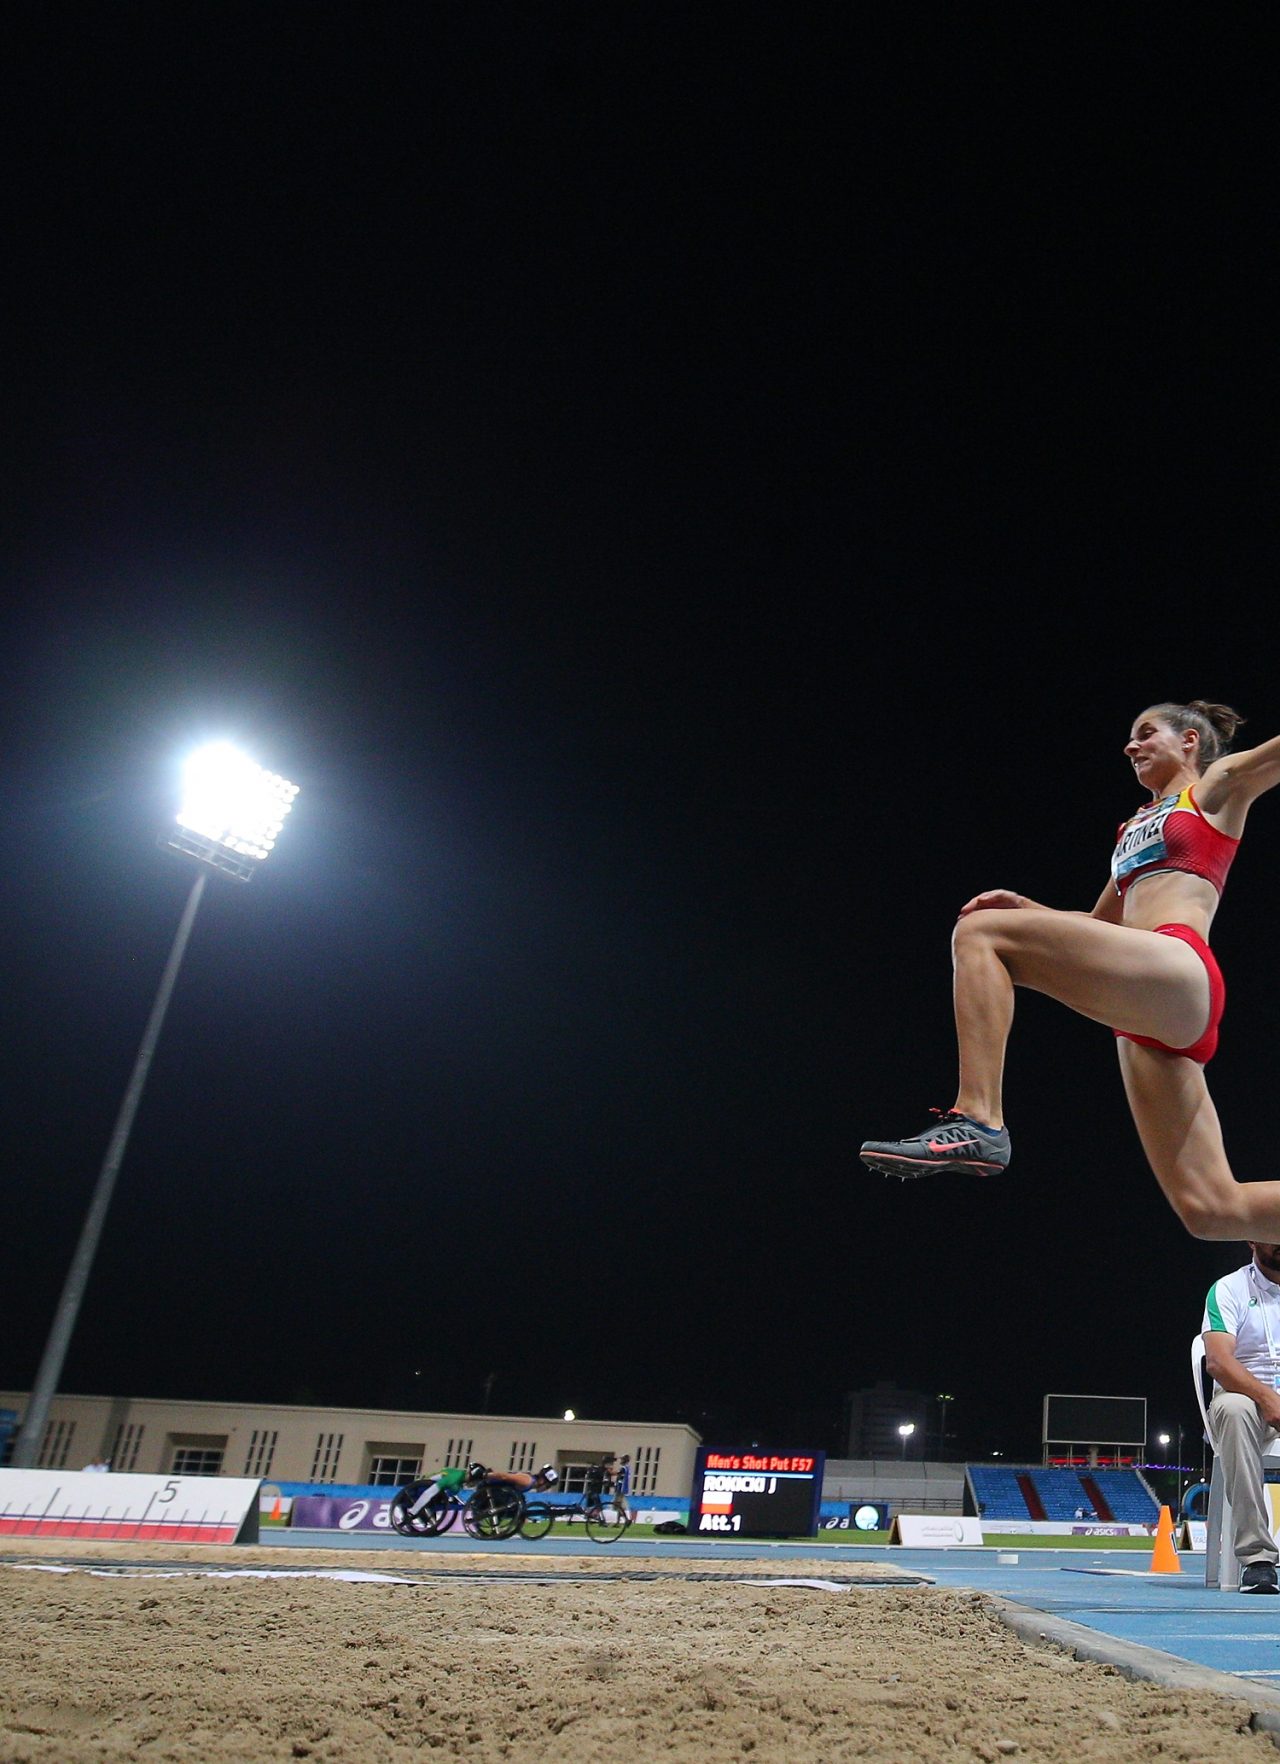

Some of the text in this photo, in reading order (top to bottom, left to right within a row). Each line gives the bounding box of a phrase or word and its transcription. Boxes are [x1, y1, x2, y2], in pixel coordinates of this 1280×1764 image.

[1116, 813, 1167, 857] ARTINEZ
[707, 1454, 814, 1472] Men's Shot Put F57
[158, 1480, 181, 1503] 5
[768, 1477, 777, 1494] J
